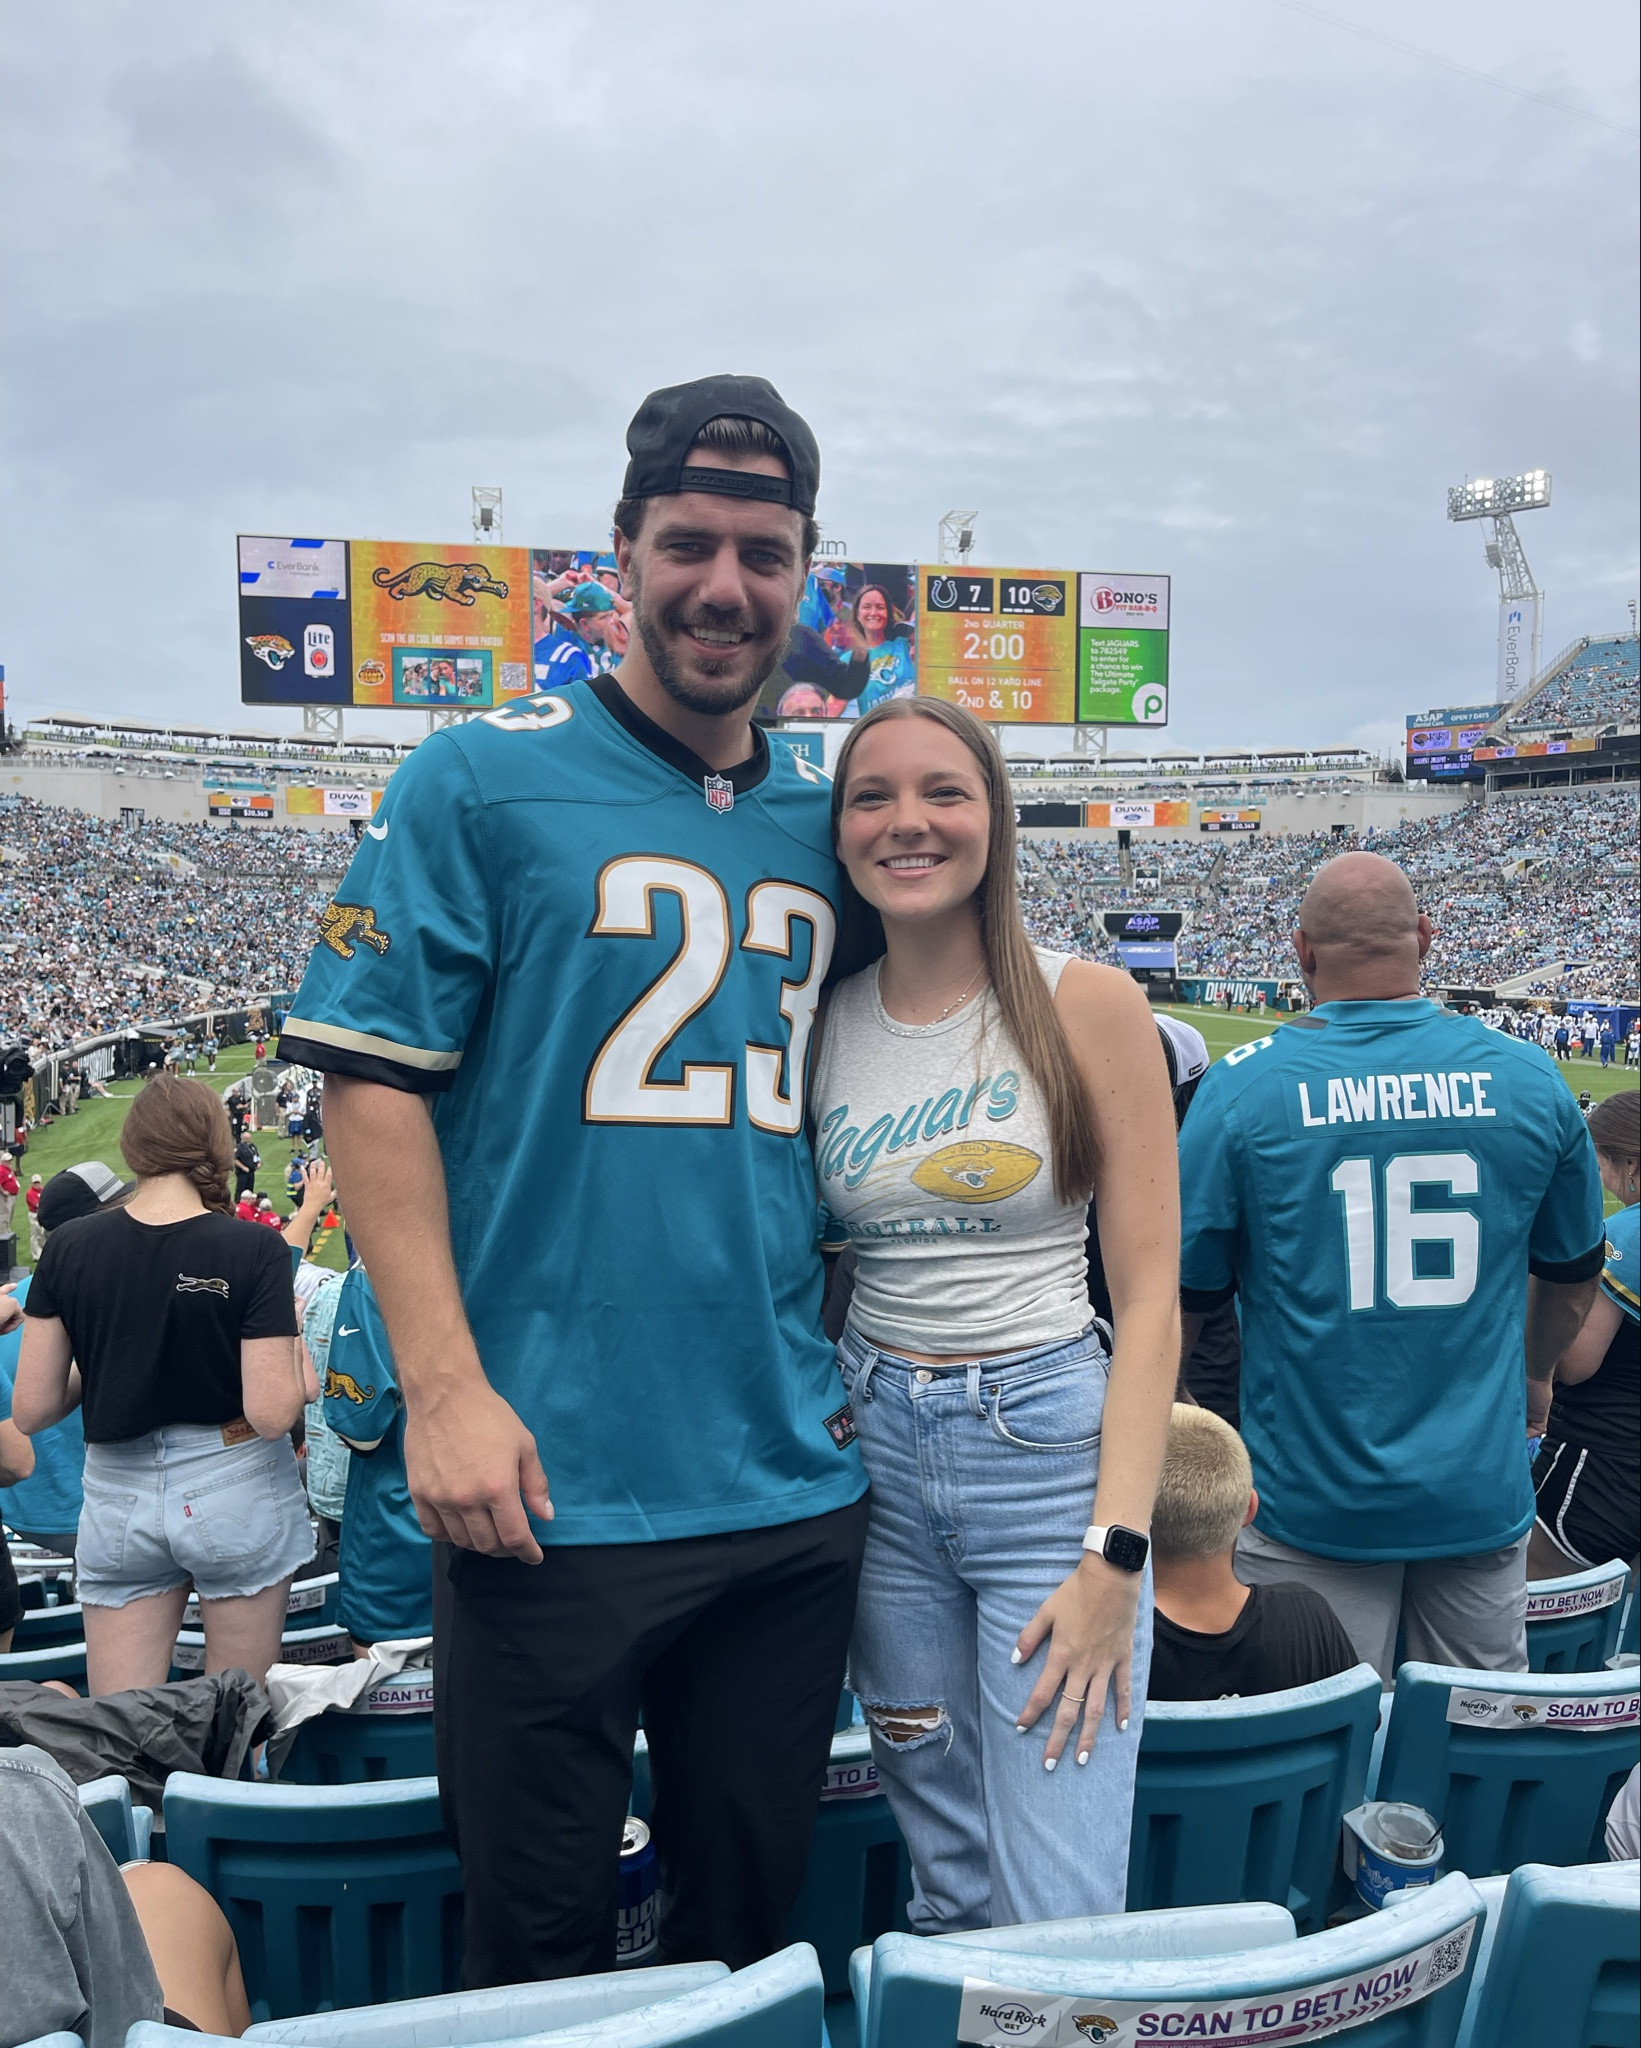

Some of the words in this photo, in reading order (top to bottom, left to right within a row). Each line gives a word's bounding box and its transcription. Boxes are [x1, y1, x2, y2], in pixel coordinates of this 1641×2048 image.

[815, 540, 847, 556] um
[277, 561, 320, 572] EverBank
[970, 585, 982, 603] 7
[1008, 586, 1031, 605] 10
[1096, 591, 1158, 610] BONO'S
[983, 620, 1025, 629] QUARTER
[308, 632, 330, 647] Lite
[963, 632, 1025, 661] 2:00
[1107, 640, 1139, 648] JAGUARS
[1505, 626, 1520, 693] EverBank
[948, 676, 969, 685] BALL
[998, 678, 1021, 687] YARD
[1023, 678, 1043, 687] LINE
[956, 689, 985, 709] 2ND
[989, 690, 1004, 709] &
[1011, 690, 1032, 710] 10
[1416, 713, 1443, 722] ASAP
[1474, 712, 1490, 720] DAYS
[329, 792, 368, 801] DUVAL
[711, 789, 731, 807] NFL
[1127, 916, 1159, 925] ASAP
[581, 851, 838, 1138] 23
[1298, 1072, 1496, 1127] LAWRENCE
[822, 1069, 1020, 1191] Jaguars
[848, 1217, 1001, 1239] OOTBALL
[1329, 1150, 1482, 1312] 16
[1537, 1598, 1554, 1609] TO
[1558, 1595, 1578, 1606] BET
[1580, 1588, 1604, 1602] NOW
[282, 1648, 305, 1660] BET
[308, 1641, 338, 1655] NOW
[369, 1690, 411, 1702] SCAN
[415, 1688, 434, 1700] TO
[1460, 1700, 1479, 1709] Hard
[1479, 1703, 1498, 1713] Rock
[1547, 1704, 1598, 1718] SCAN
[1604, 1701, 1625, 1716] TO
[834, 1769, 861, 1785] TO
[618, 1894, 655, 1929] UD
[617, 1919, 652, 1952] GH
[980, 2005, 1015, 2021] Hard
[1015, 2010, 1048, 2028] Rock
[1136, 2011, 1233, 2037] SCAN
[1243, 2005, 1284, 2031] TO
[1291, 1987, 1349, 2022] BET
[1353, 1960, 1419, 2005] NOW
[1004, 2022, 1021, 2031] BET
